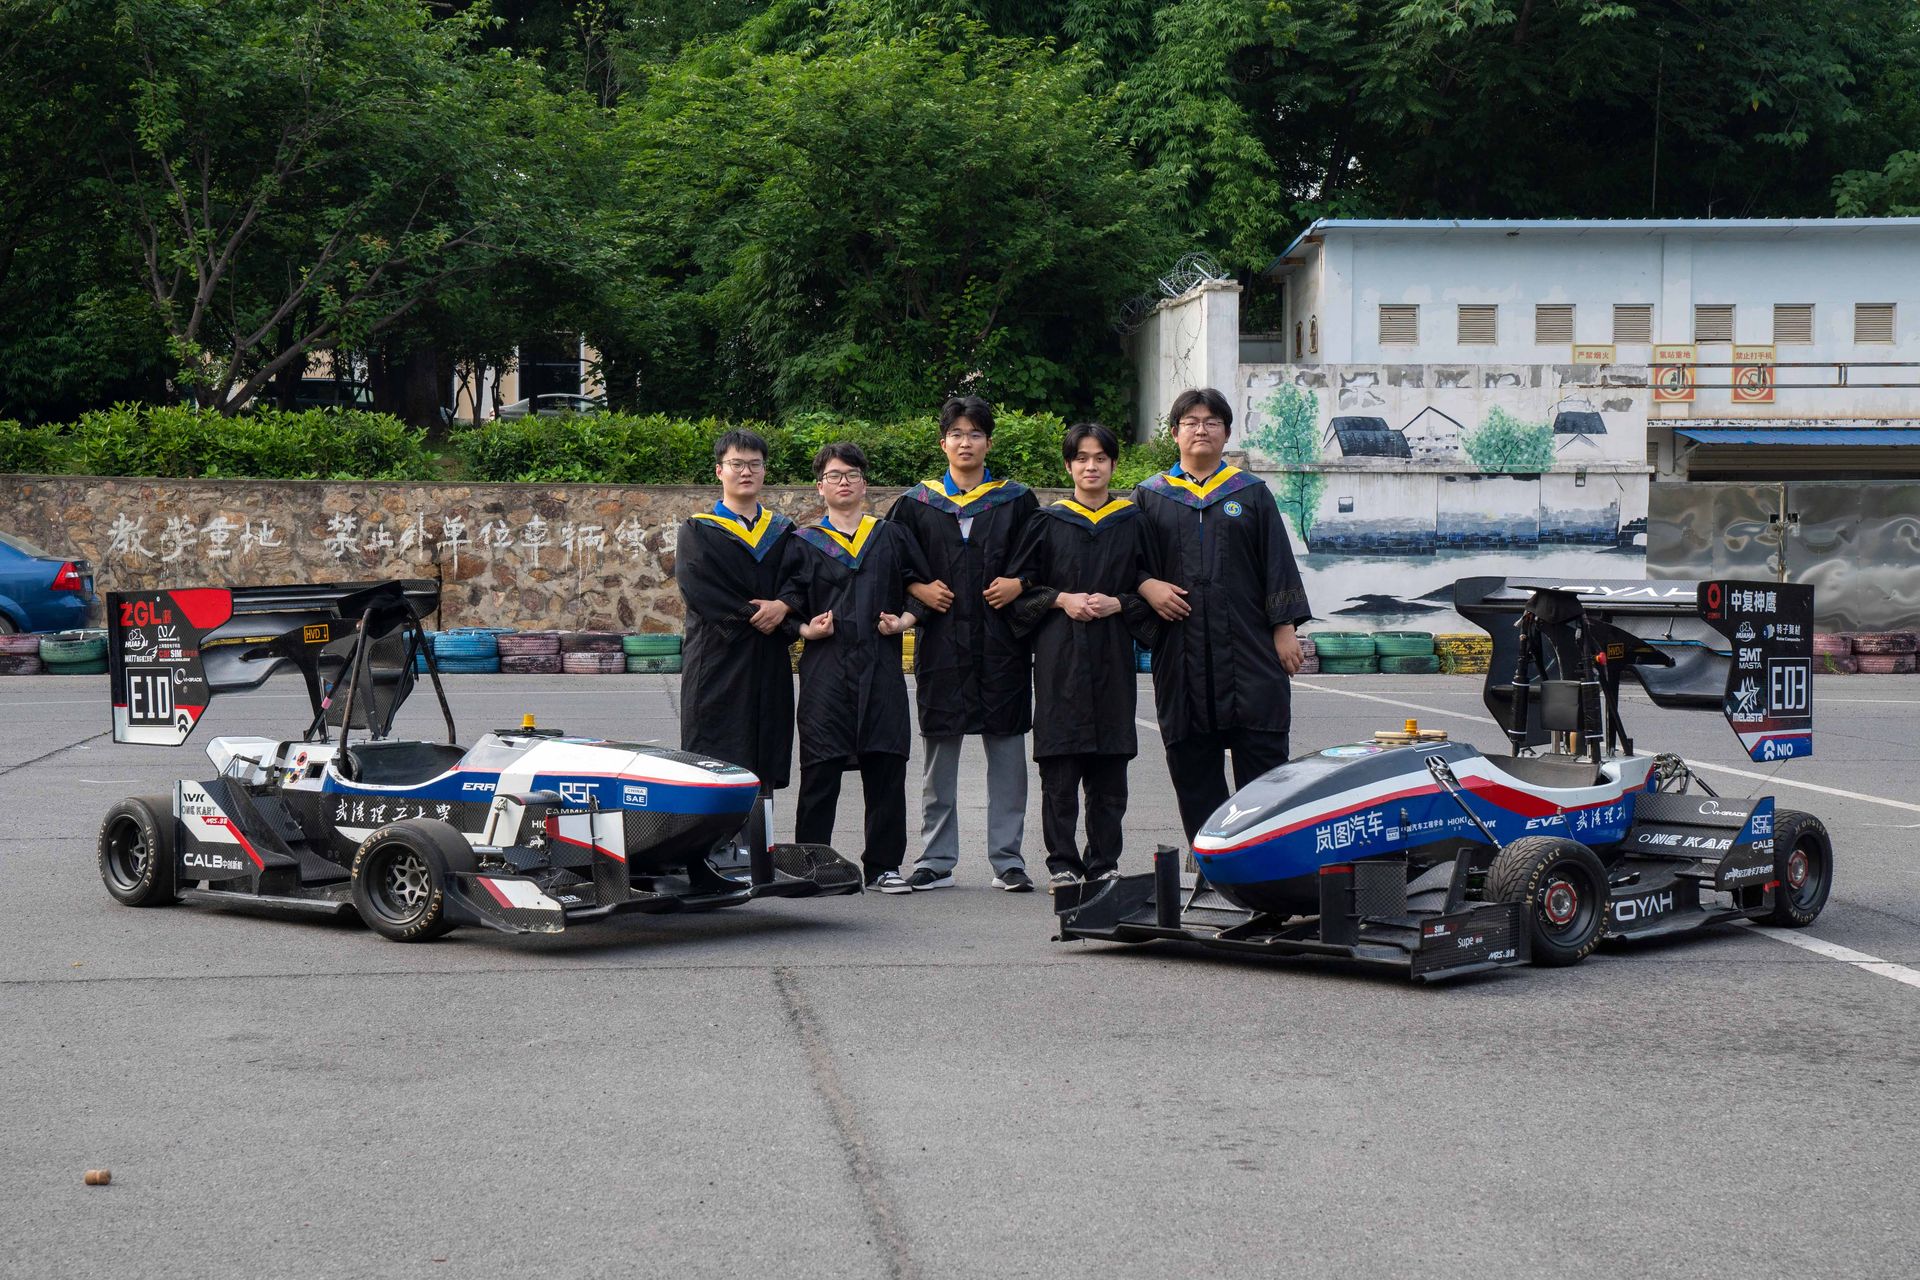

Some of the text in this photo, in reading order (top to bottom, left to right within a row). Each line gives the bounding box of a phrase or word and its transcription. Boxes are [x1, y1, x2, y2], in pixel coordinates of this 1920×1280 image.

[1735, 351, 1773, 360] 禁止打手机
[1731, 590, 1777, 613] 中复神鹰
[120, 600, 161, 627] ZGL
[1739, 648, 1762, 662] SMT
[1771, 665, 1806, 710] E03
[130, 675, 170, 719] E10
[1777, 743, 1793, 756] NIO
[462, 783, 496, 791] ERA
[626, 794, 645, 803] SAE
[1447, 816, 1467, 826] HIOKI
[1525, 814, 1566, 830] EVE
[1316, 811, 1384, 854] 岚图汽车
[1682, 837, 1733, 850] KAR
[1752, 839, 1774, 850] CALB
[183, 853, 223, 868] CALB
